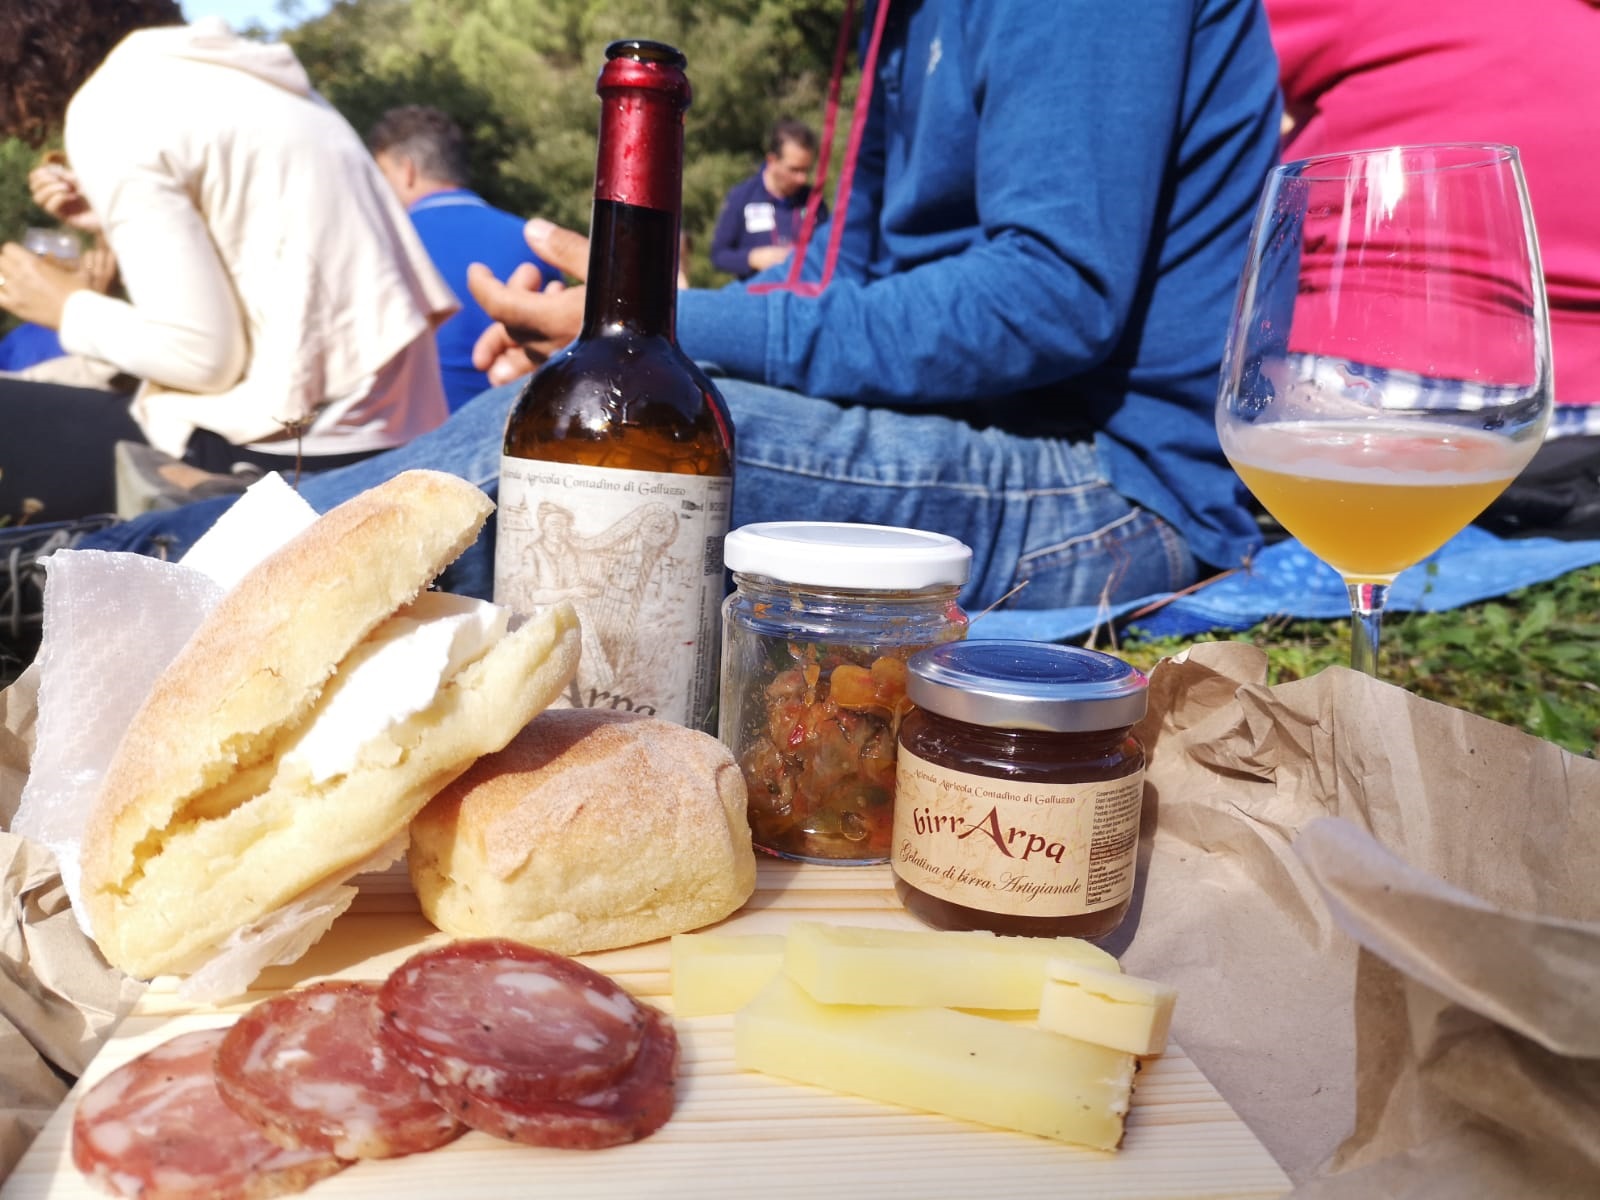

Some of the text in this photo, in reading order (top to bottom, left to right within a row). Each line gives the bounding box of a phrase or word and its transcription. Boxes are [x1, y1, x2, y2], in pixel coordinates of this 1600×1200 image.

[524, 472, 561, 487] Agricola
[562, 474, 621, 491] Contadino
[623, 481, 635, 493] di
[939, 779, 973, 795] Agricola
[974, 786, 1021, 802] Contadino
[1023, 794, 1032, 804] di
[1034, 795, 1076, 806] Galluzzo
[913, 805, 1067, 865] birrArpa
[899, 839, 941, 875] Gelatina
[942, 865, 955, 880] di
[957, 869, 991, 889] birra
[993, 871, 1082, 902] Artigianale
